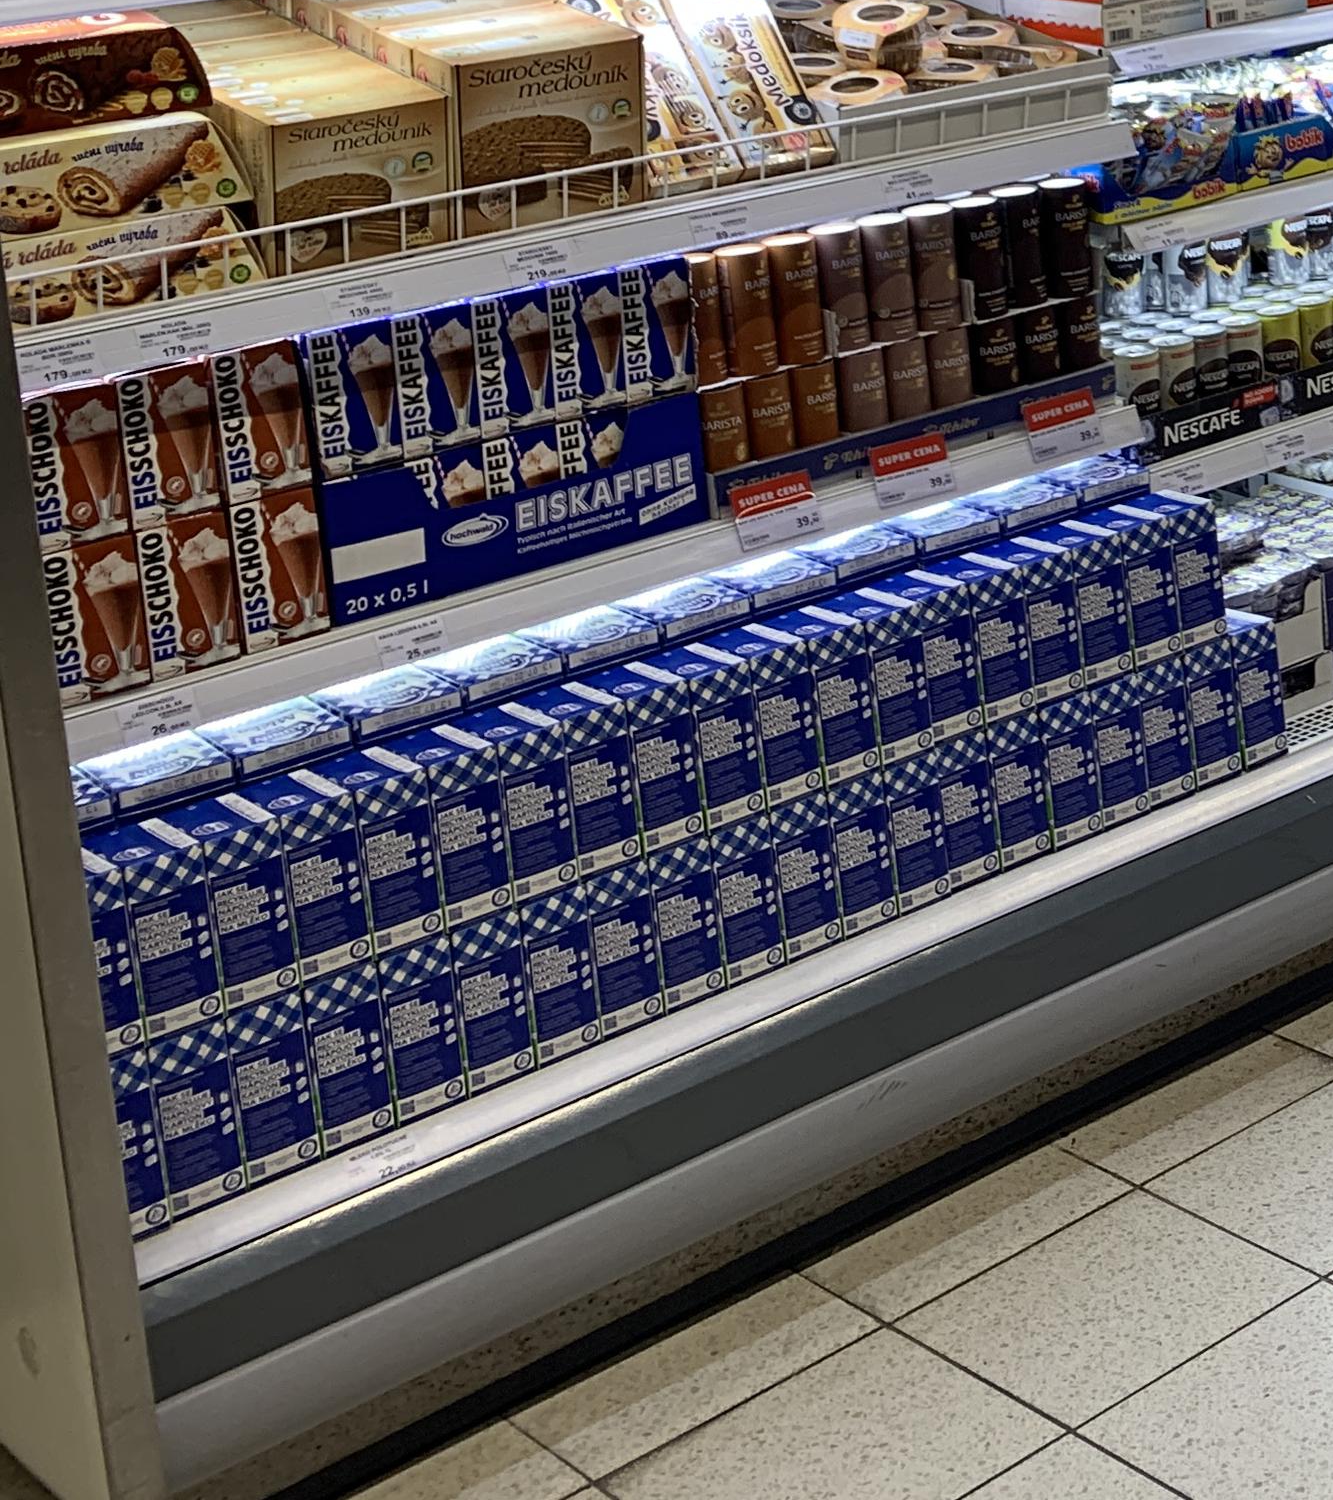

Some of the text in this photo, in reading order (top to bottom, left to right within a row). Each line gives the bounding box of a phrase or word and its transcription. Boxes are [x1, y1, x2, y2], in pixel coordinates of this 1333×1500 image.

[468, 50, 593, 88] Staročeský
[735, 22, 791, 107] Medoksík
[518, 64, 629, 100] medovník
[288, 111, 400, 144] Staročeský
[332, 121, 433, 153] medovník
[1284, 127, 1326, 152] bobik
[1191, 178, 1227, 200] bobik
[622, 269, 649, 385] EISKAFFEE
[548, 284, 579, 408] EISKAFFEE
[473, 298, 504, 432] EISKAFFEE
[394, 314, 427, 442] EISKAFFEE
[311, 332, 346, 461] EISKAFFEE
[214, 354, 253, 485] EISSCHOKO
[702, 414, 743, 431] ARISTA
[1030, 398, 1091, 424] SUPER CENA
[120, 377, 158, 510] EISSCHOKO
[877, 443, 942, 468] SUPER CENA
[28, 400, 63, 537] EISSCHOKO
[514, 452, 694, 533] EISKAFFEE
[738, 482, 807, 509] SUPER CENA
[449, 522, 496, 542] hochwald
[232, 505, 272, 637] EISSCHOKO
[140, 530, 177, 664] EISSCHOKO
[345, 597, 369, 616] 20
[372, 595, 385, 609] x
[389, 582, 418, 606] 0,5
[46, 554, 83, 689] EISSCHOKO
[291, 855, 321, 872] JAK SE
[292, 858, 339, 879] RECYKLUJE
[293, 867, 342, 888] NÁPOJOVÝ
[294, 878, 332, 898] KARTON
[216, 883, 247, 900] JAK SE
[217, 886, 266, 907] RECYKLUJE
[295, 883, 342, 906] NA MLÉKO
[217, 894, 269, 916] NÁPOJOVÝ
[218, 906, 259, 925] KARTON
[136, 910, 170, 927] JAK SE
[138, 912, 188, 934] RECYKLUJE
[220, 910, 270, 934] NA MLÉKO
[138, 920, 192, 943] NÁPOJOVÝ
[140, 933, 181, 952] KARTON
[140, 938, 192, 961] NA MLÉKO
